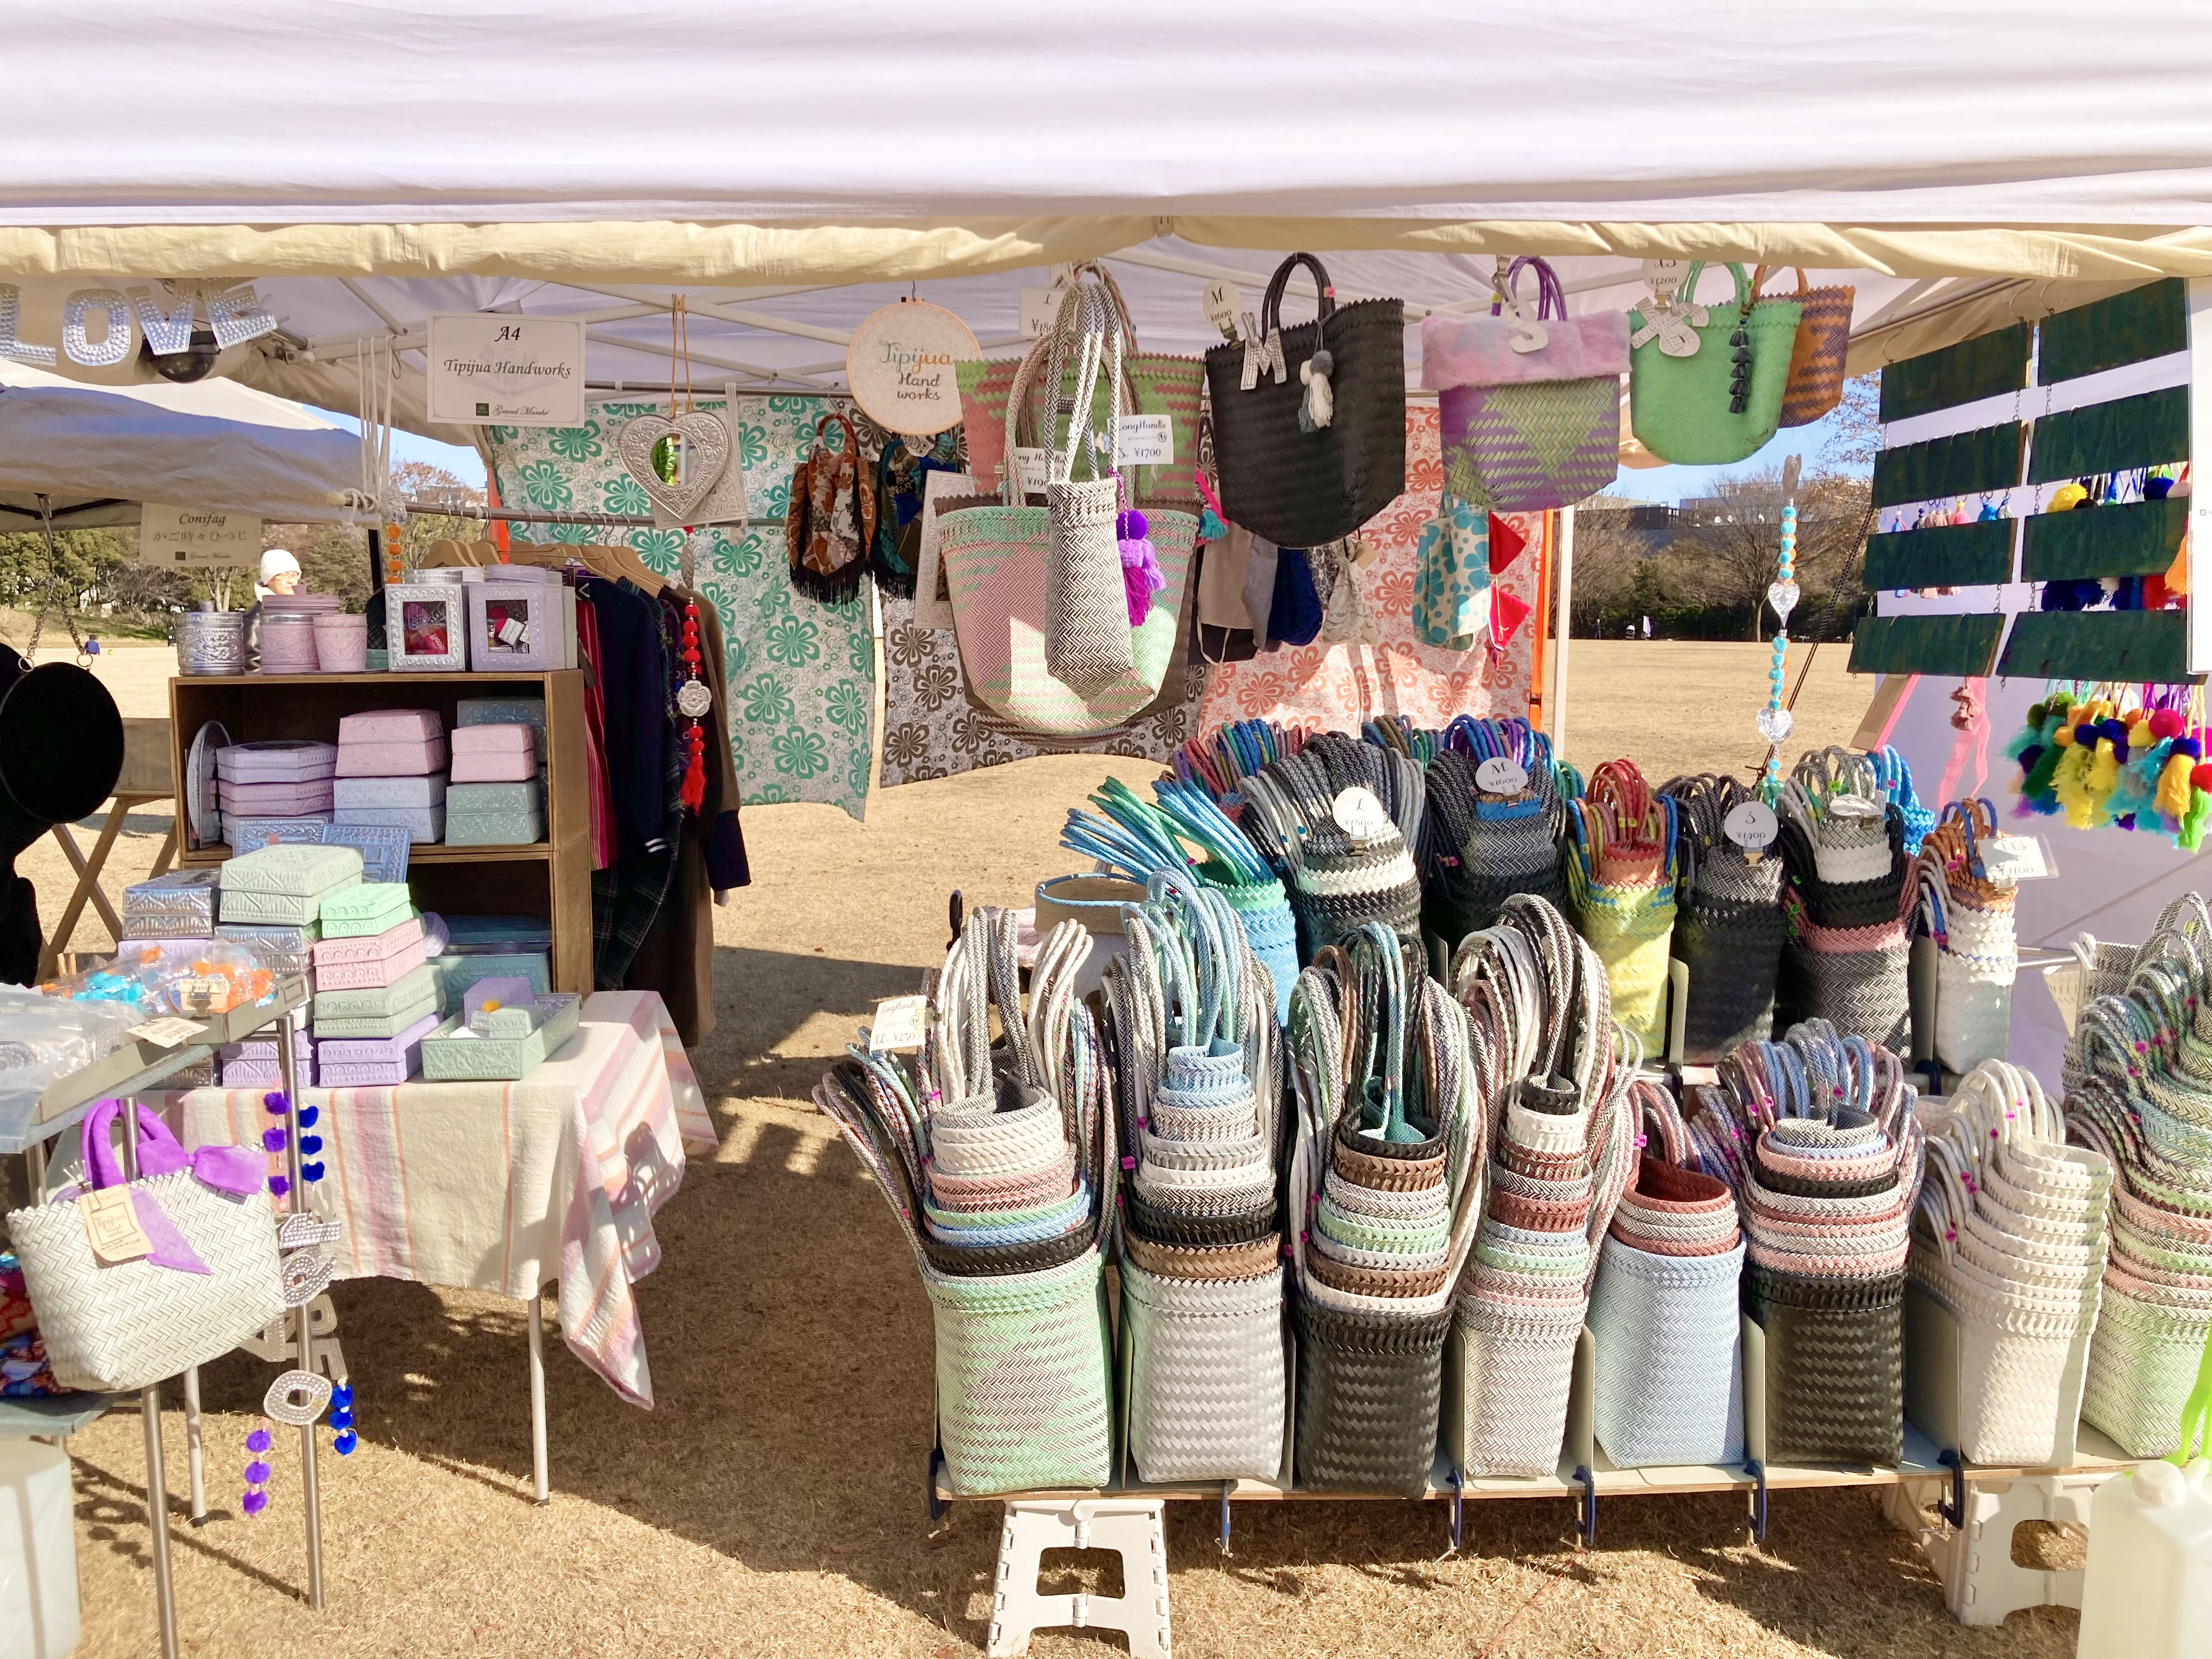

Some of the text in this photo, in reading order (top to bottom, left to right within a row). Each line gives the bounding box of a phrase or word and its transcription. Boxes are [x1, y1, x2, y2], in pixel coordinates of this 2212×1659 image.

[1043, 294, 1052, 306] L
[1210, 286, 1224, 306] M
[1210, 309, 1232, 323] ¥1600
[494, 326, 521, 342] A4
[879, 340, 955, 374] Tipijua
[444, 359, 572, 379] Tipijua Handworks
[898, 372, 940, 386] Hand
[897, 387, 941, 400] works
[493, 404, 518, 416] Grand
[1133, 447, 1161, 459] ¥1700
[179, 512, 226, 527] Conifag
[1491, 761, 1509, 775] M
[1488, 777, 1517, 787] ¥1600
[1353, 797, 1368, 812] L
[1344, 817, 1374, 827] ¥1800
[1745, 810, 1758, 824] S
[1736, 831, 1766, 840] ¥1400
[893, 1032, 921, 1043] ¥2500
